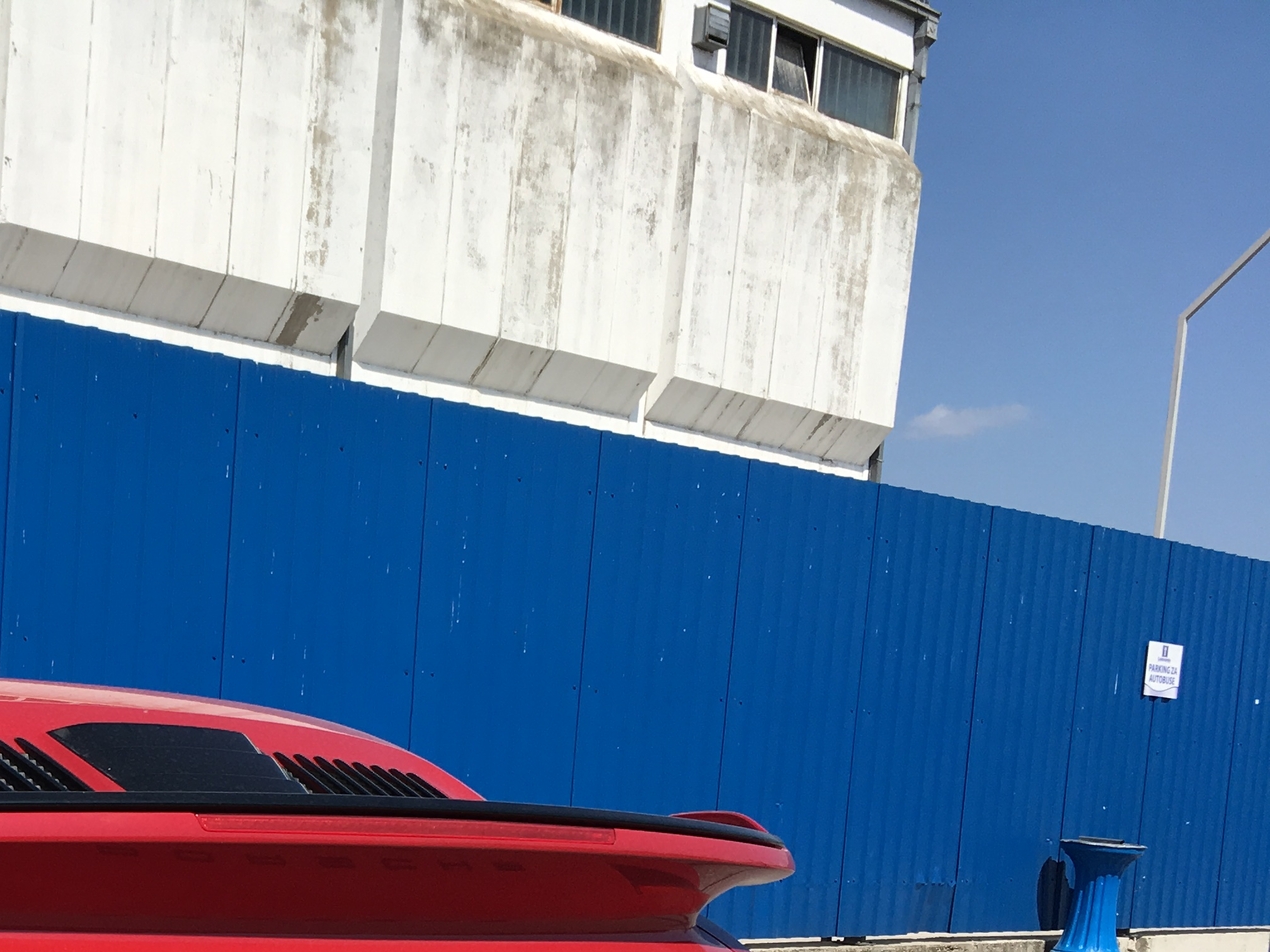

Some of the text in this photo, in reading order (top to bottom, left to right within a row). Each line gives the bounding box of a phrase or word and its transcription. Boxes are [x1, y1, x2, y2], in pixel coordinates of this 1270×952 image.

[1149, 664, 1178, 675] PARKING ZA
[1150, 674, 1175, 685] AUTOBUSE
